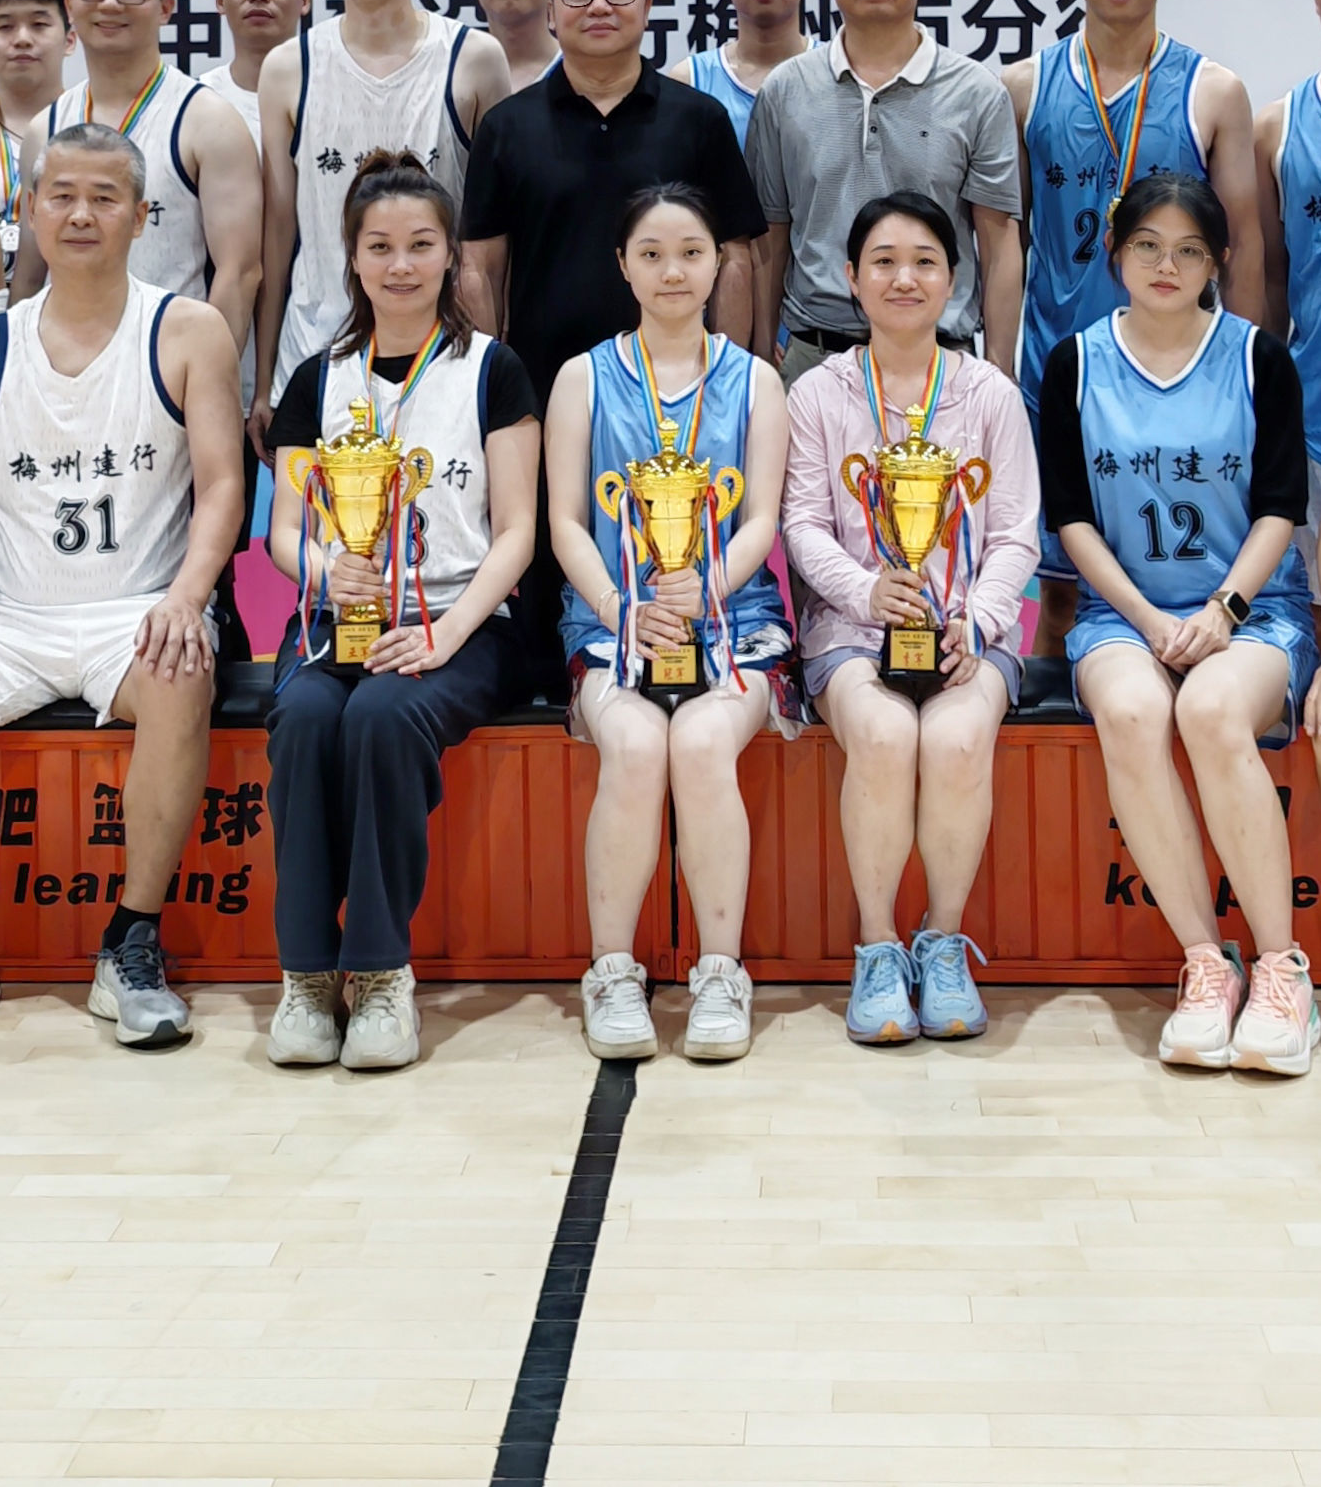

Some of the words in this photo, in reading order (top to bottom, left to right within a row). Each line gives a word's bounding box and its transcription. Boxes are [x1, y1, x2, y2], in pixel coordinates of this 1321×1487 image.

[9, 443, 157, 483] 梅州建行
[1093, 445, 1243, 484] 梅州建行
[53, 493, 120, 556] 31
[1138, 498, 1208, 562] 12
[13, 863, 252, 915] learing
